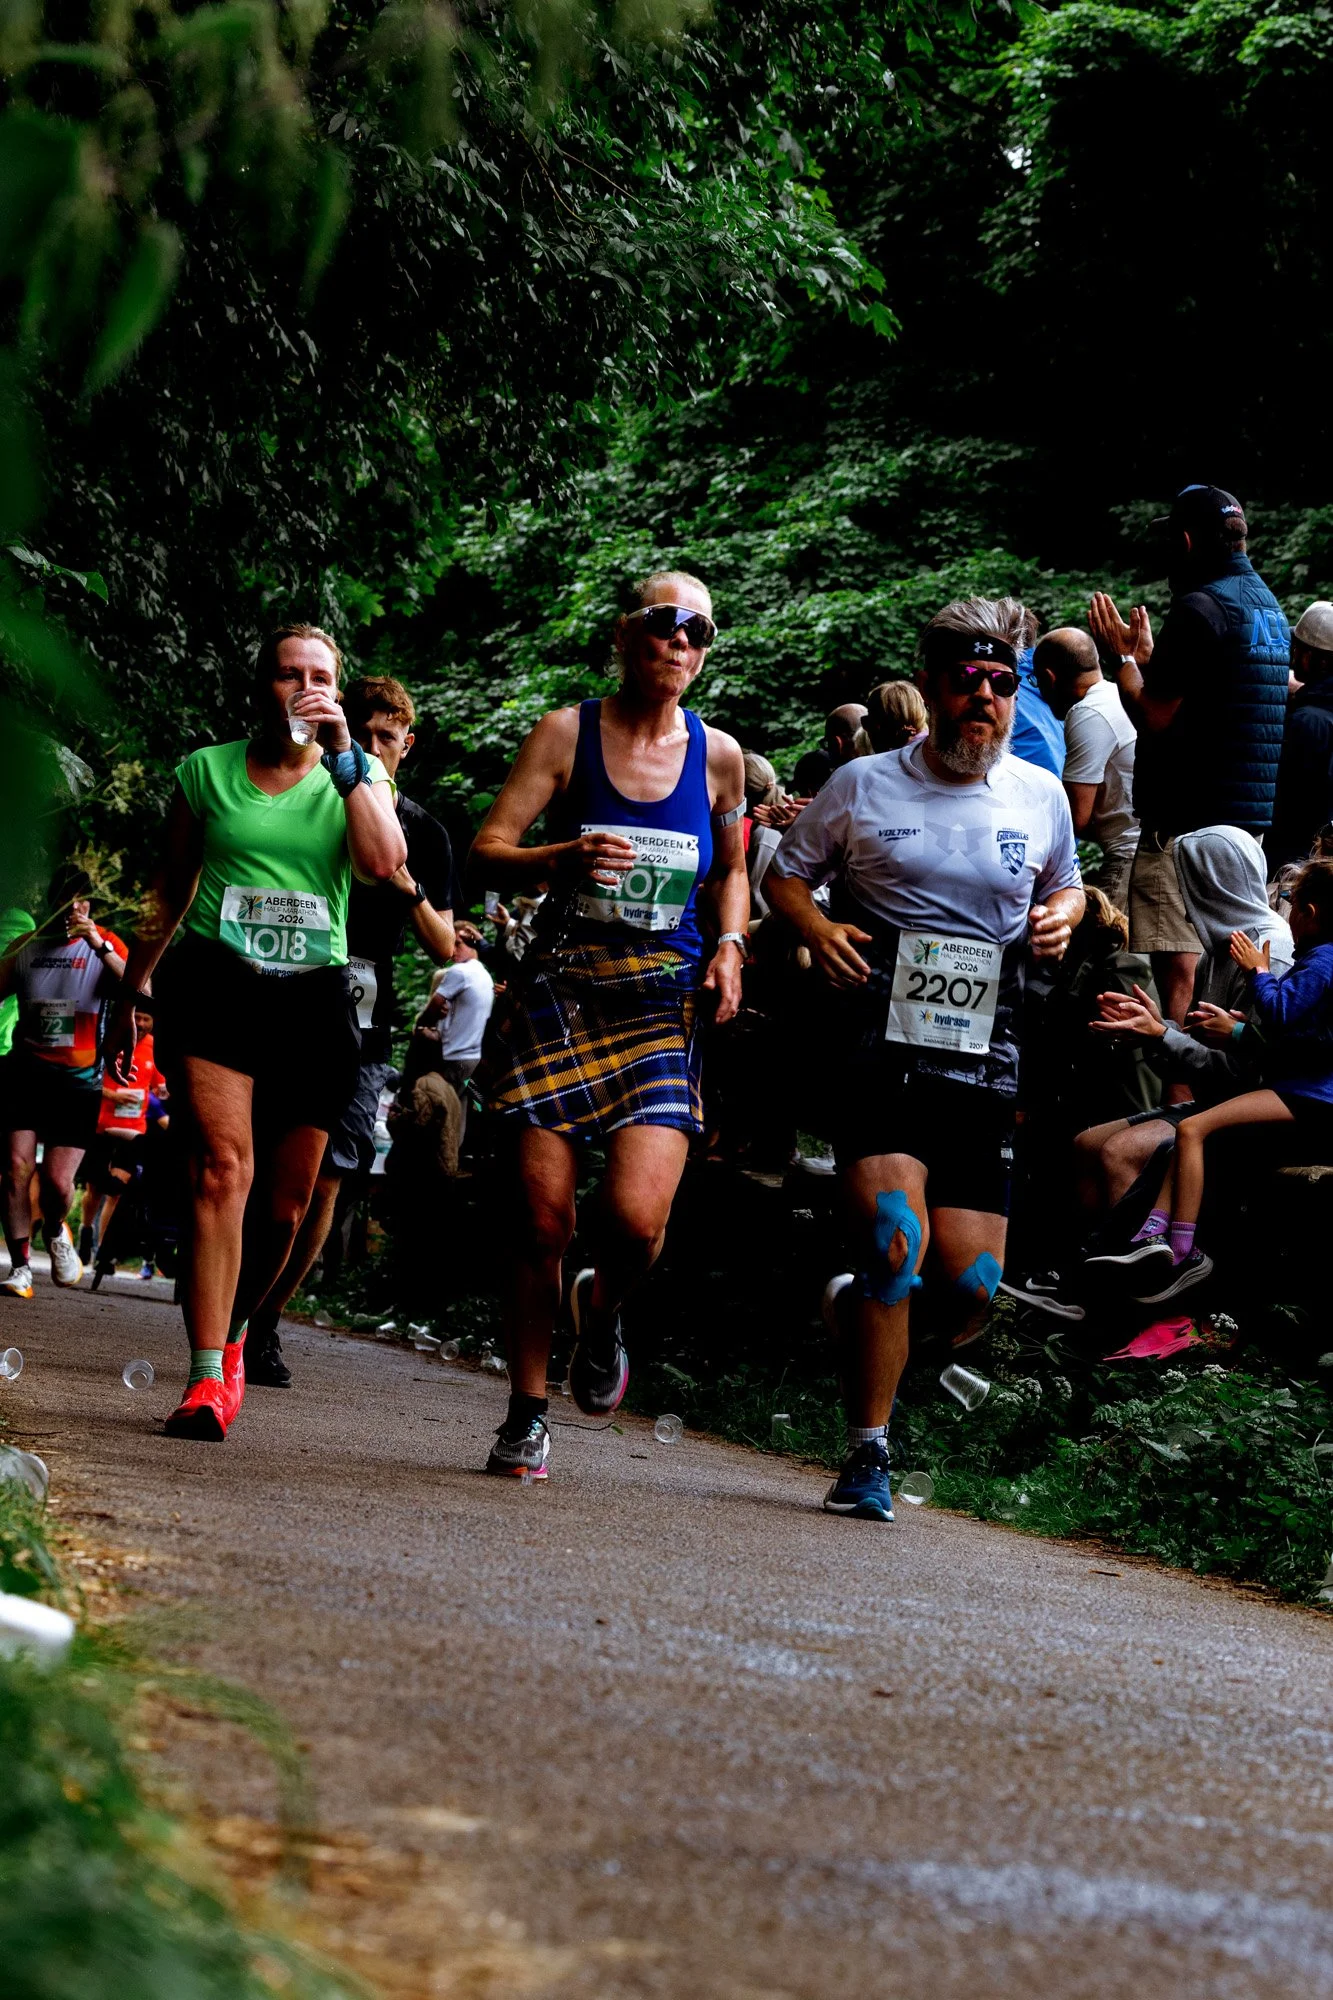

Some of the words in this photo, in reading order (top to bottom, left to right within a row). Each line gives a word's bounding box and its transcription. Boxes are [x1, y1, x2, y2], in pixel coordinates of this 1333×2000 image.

[878, 828, 917, 837] VOLTRA
[641, 853, 669, 864] 2026
[606, 868, 672, 901] 107
[264, 896, 317, 910] ABERDEEN
[263, 906, 281, 914] HALF
[283, 908, 318, 917] MARATHON
[278, 914, 304, 925] 2026
[244, 926, 307, 961] 1018
[941, 943, 993, 959] ABERDEEN
[941, 952, 957, 961] HALF
[960, 955, 991, 966] MARATHON
[953, 961, 979, 973] 2026
[906, 971, 989, 1010] 2207
[969, 1041, 984, 1050] 2207
